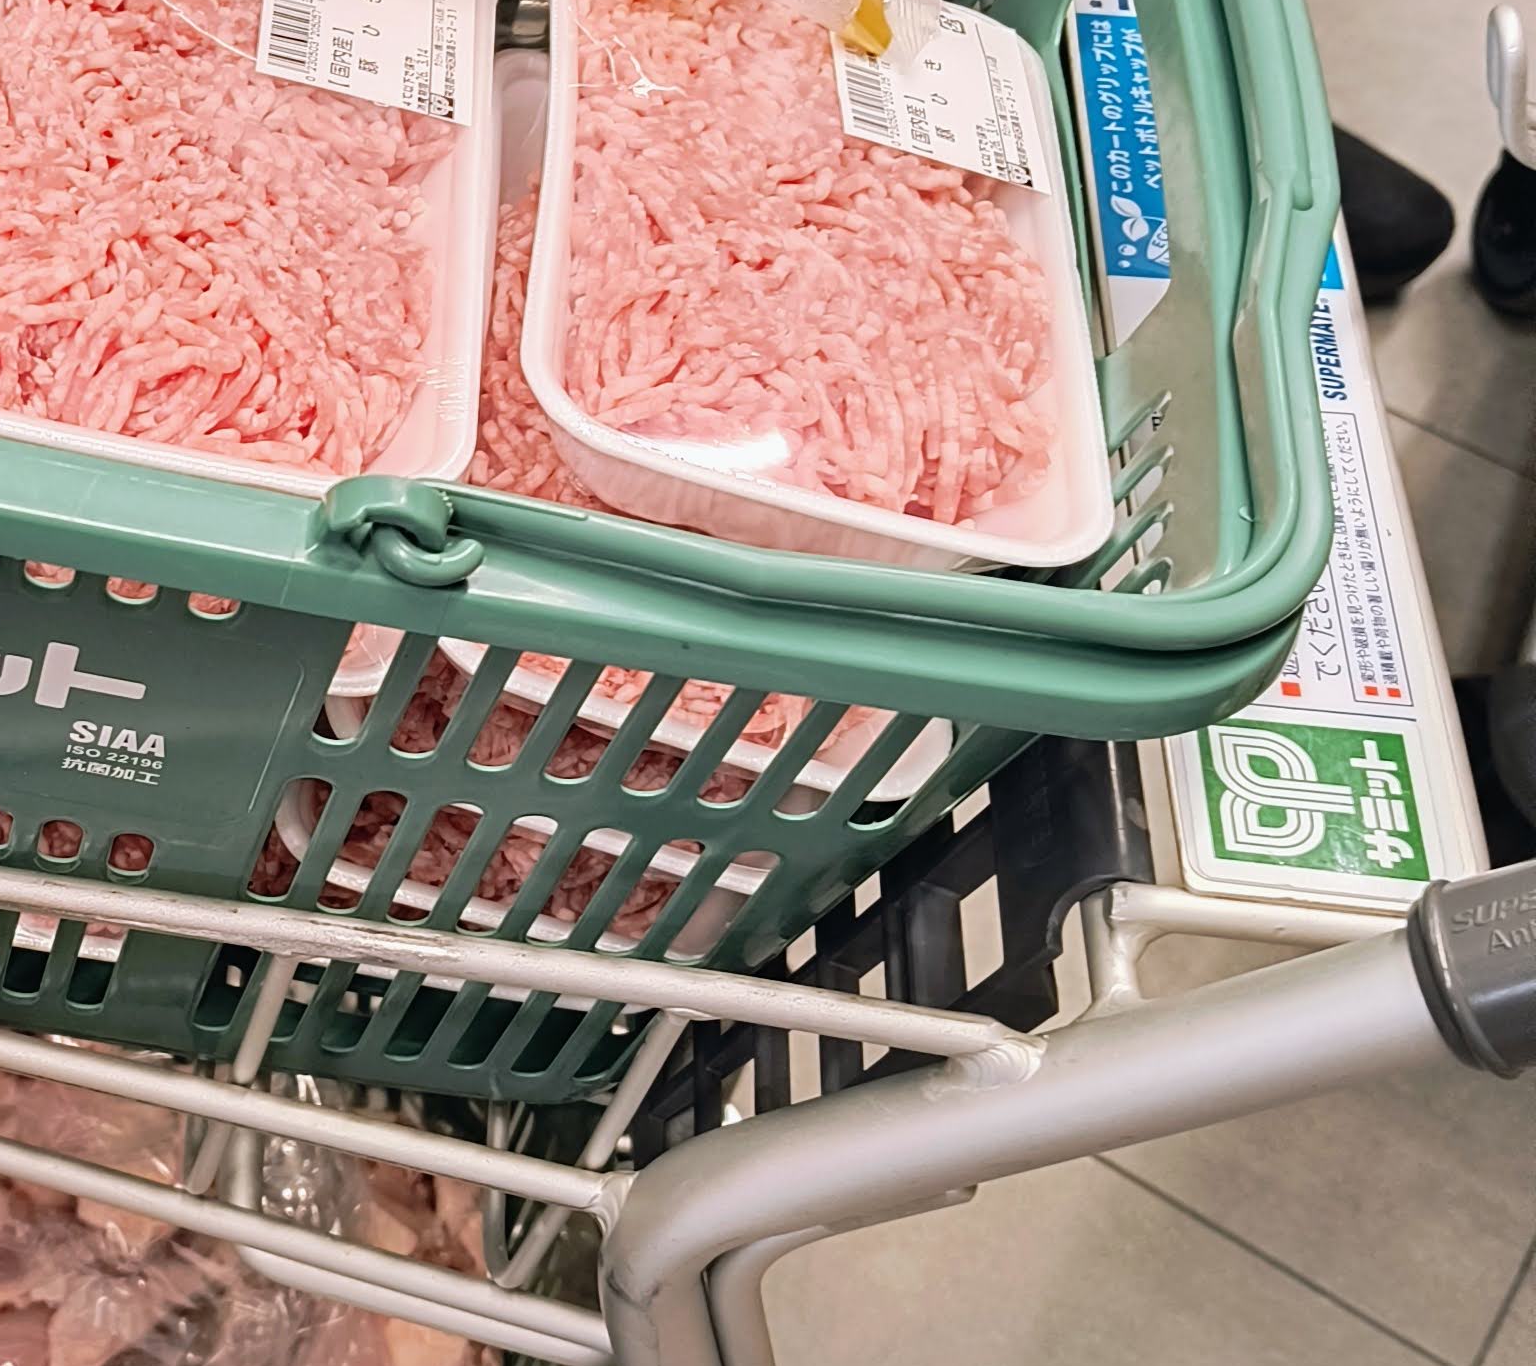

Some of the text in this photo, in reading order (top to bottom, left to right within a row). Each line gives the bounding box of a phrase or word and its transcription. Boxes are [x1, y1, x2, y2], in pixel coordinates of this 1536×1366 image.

[1091, 20, 1133, 192] このカートのグリップには
[1121, 27, 1159, 187] ペットボトルキャップが
[61, 756, 160, 788] 抗菌加工
[65, 743, 164, 772] ISO 22196
[67, 718, 167, 759] SIAA
[1350, 737, 1415, 869] サミット
